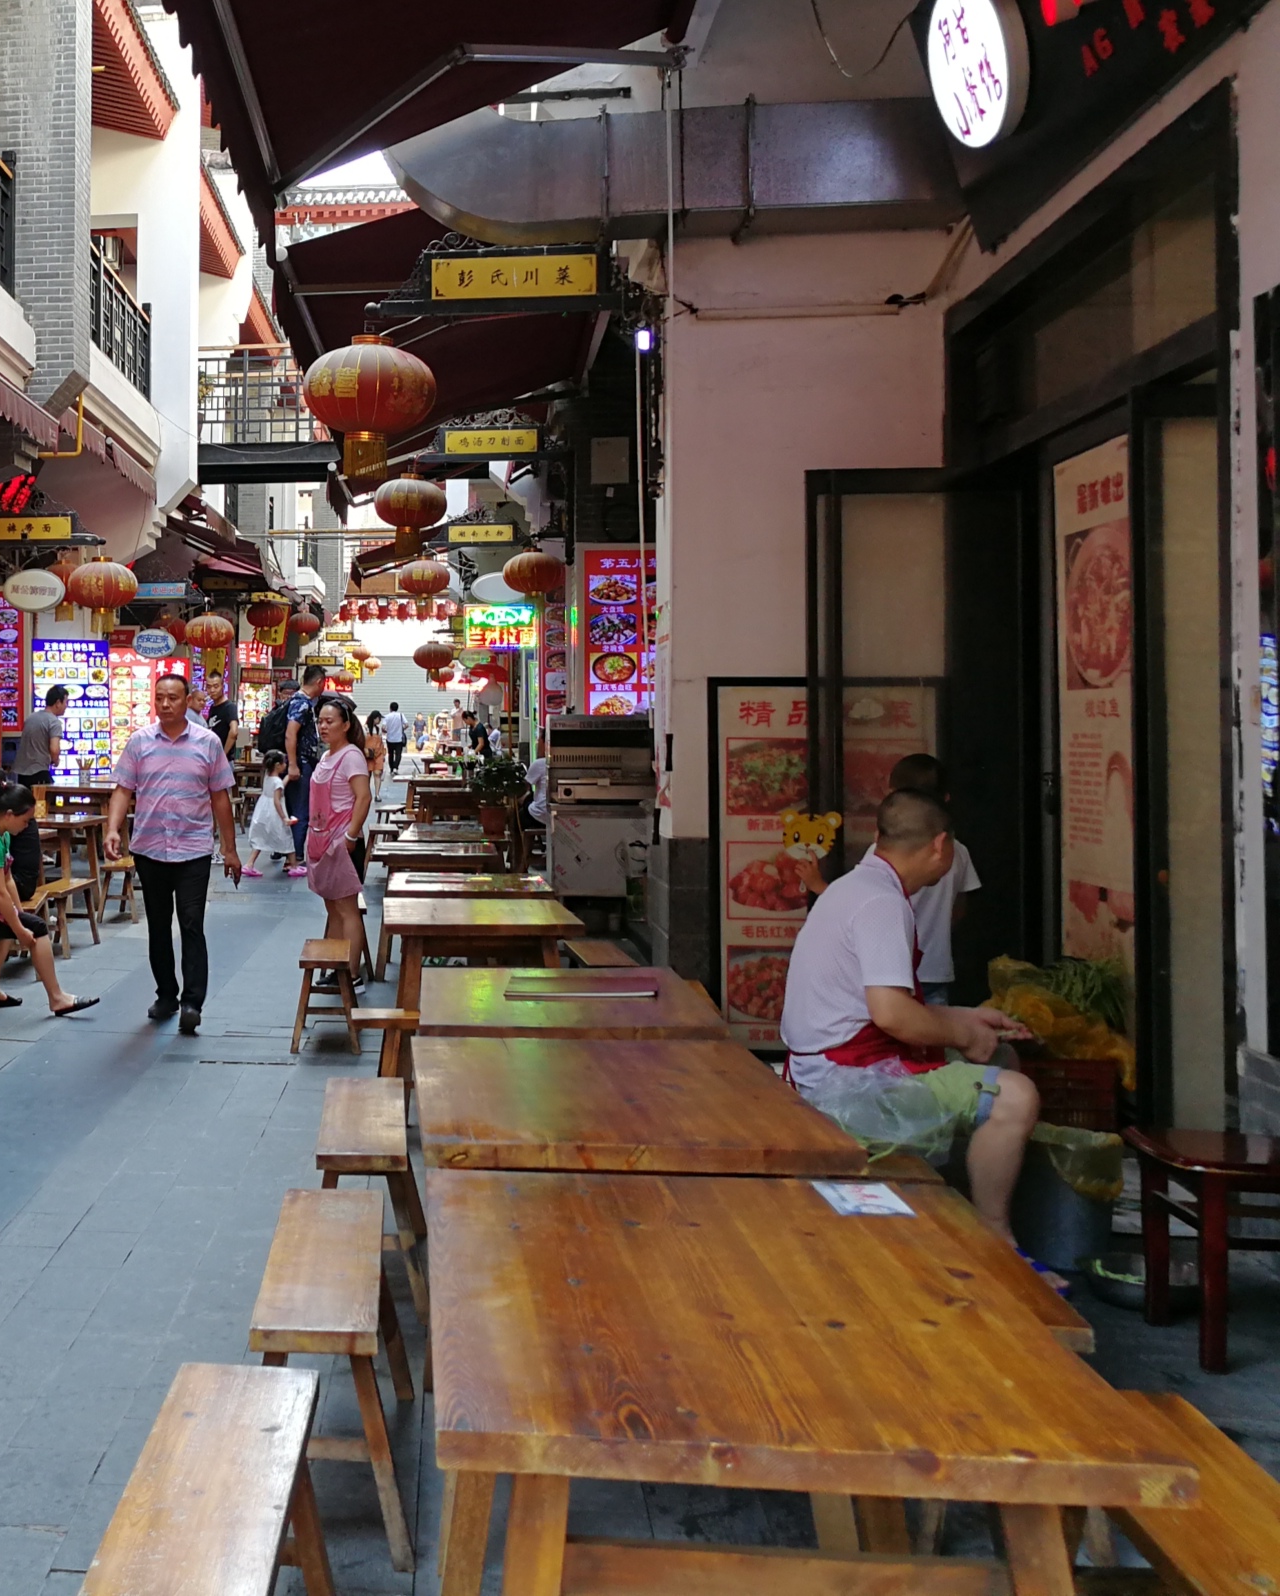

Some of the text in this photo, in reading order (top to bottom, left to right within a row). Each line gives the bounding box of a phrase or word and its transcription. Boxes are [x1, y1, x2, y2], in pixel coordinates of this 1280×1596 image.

[458, 265, 573, 288] 彭氏川菜
[470, 627, 537, 648] 兰州拉面
[741, 926, 801, 939] 毛氏红烧
